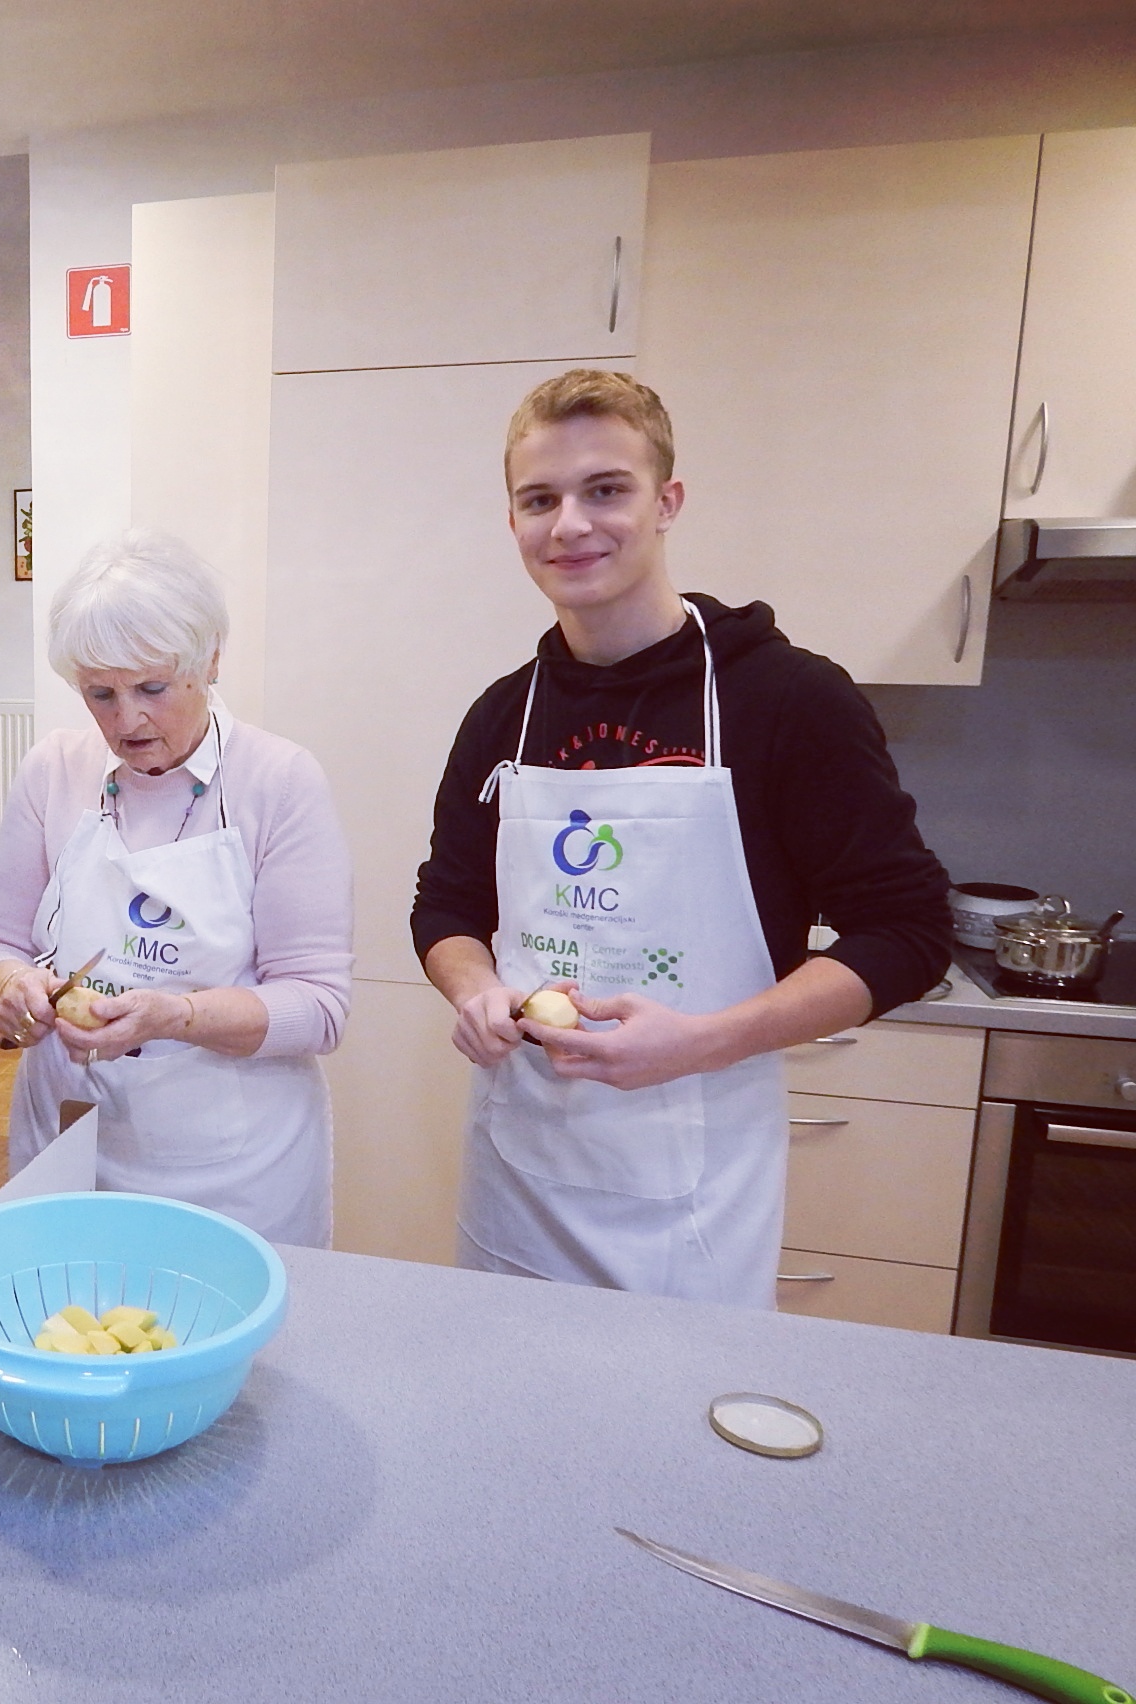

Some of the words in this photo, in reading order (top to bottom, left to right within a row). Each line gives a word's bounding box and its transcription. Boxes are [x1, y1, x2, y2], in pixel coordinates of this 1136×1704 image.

[586, 722, 659, 754] JONES
[555, 883, 619, 912] KMC
[123, 934, 179, 965] KMC
[520, 932, 579, 957] DOGAJA
[132, 960, 192, 977] medgeneracijski
[132, 971, 155, 982] center
[550, 959, 578, 979] SE!
